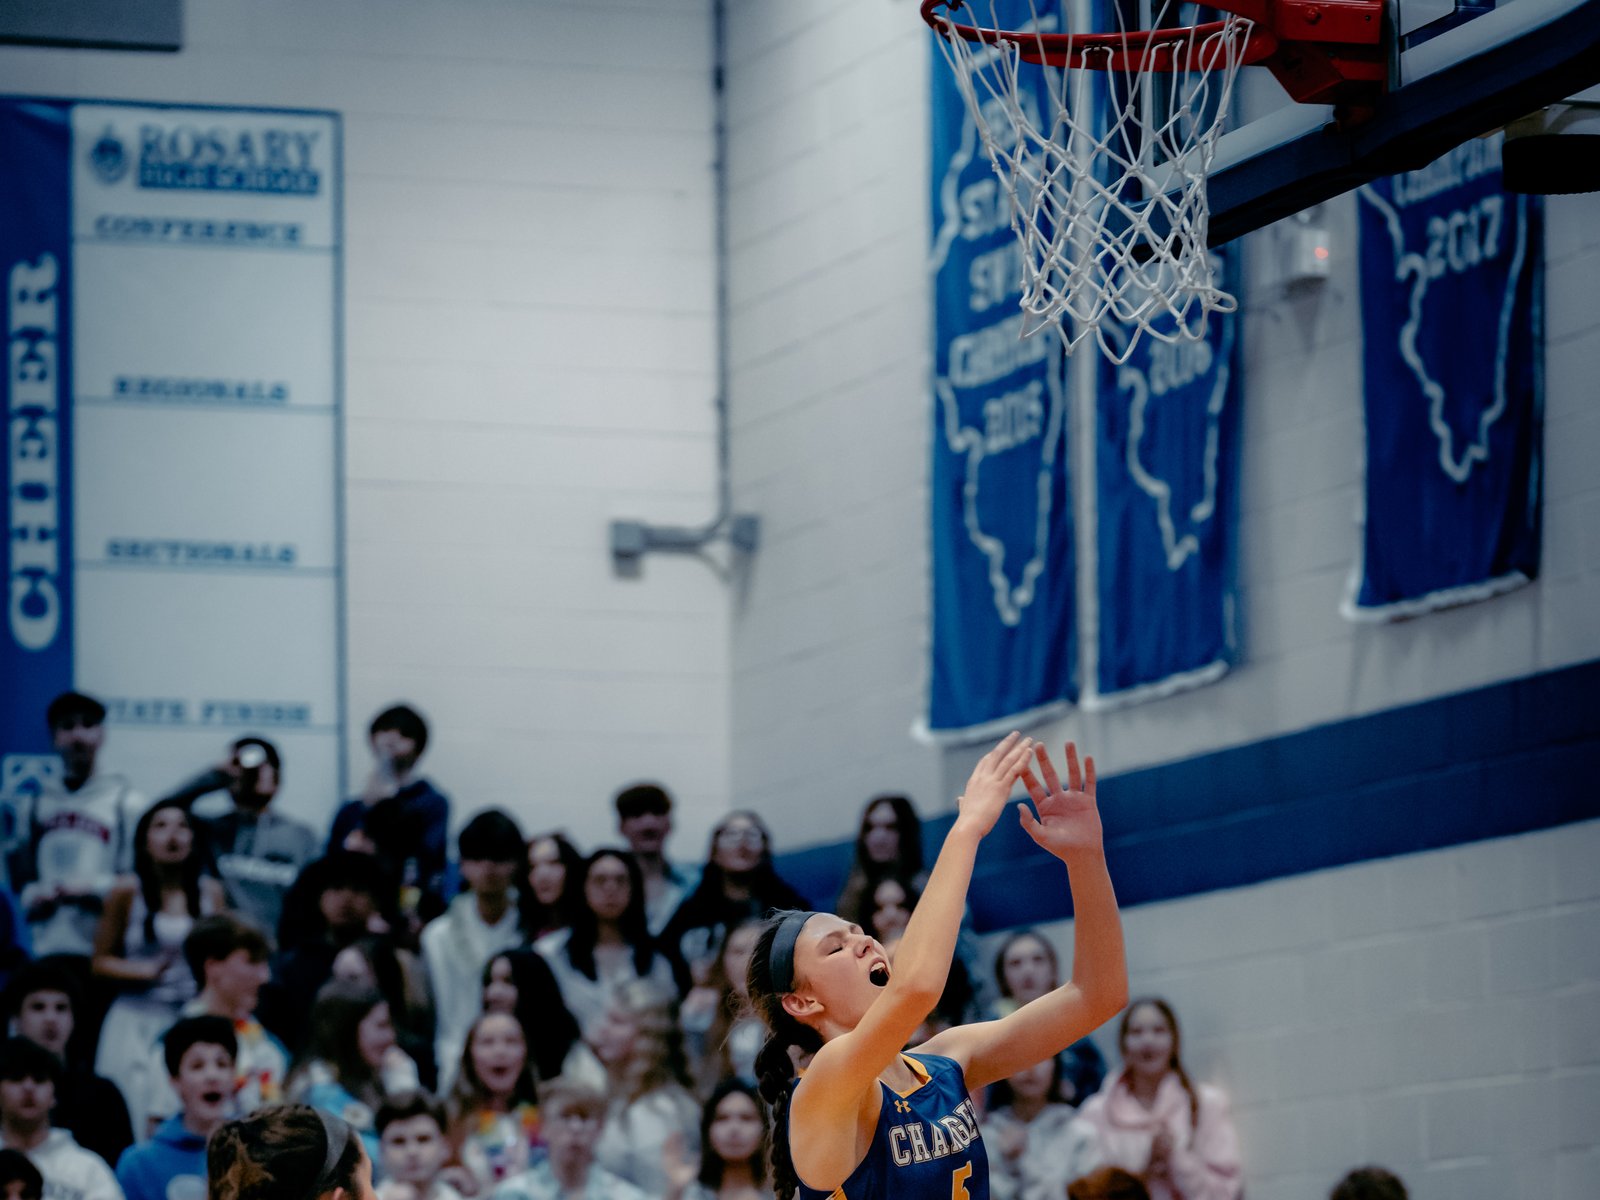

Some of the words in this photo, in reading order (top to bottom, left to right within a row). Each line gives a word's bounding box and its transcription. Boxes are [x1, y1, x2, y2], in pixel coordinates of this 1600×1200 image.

[139, 125, 320, 168] ROSARY
[96, 215, 302, 242] CONFERENCE
[1427, 194, 1503, 279] 2017
[10, 251, 59, 651] CHEER
[106, 699, 187, 723] TATE
[889, 1098, 979, 1167] CHARGE
